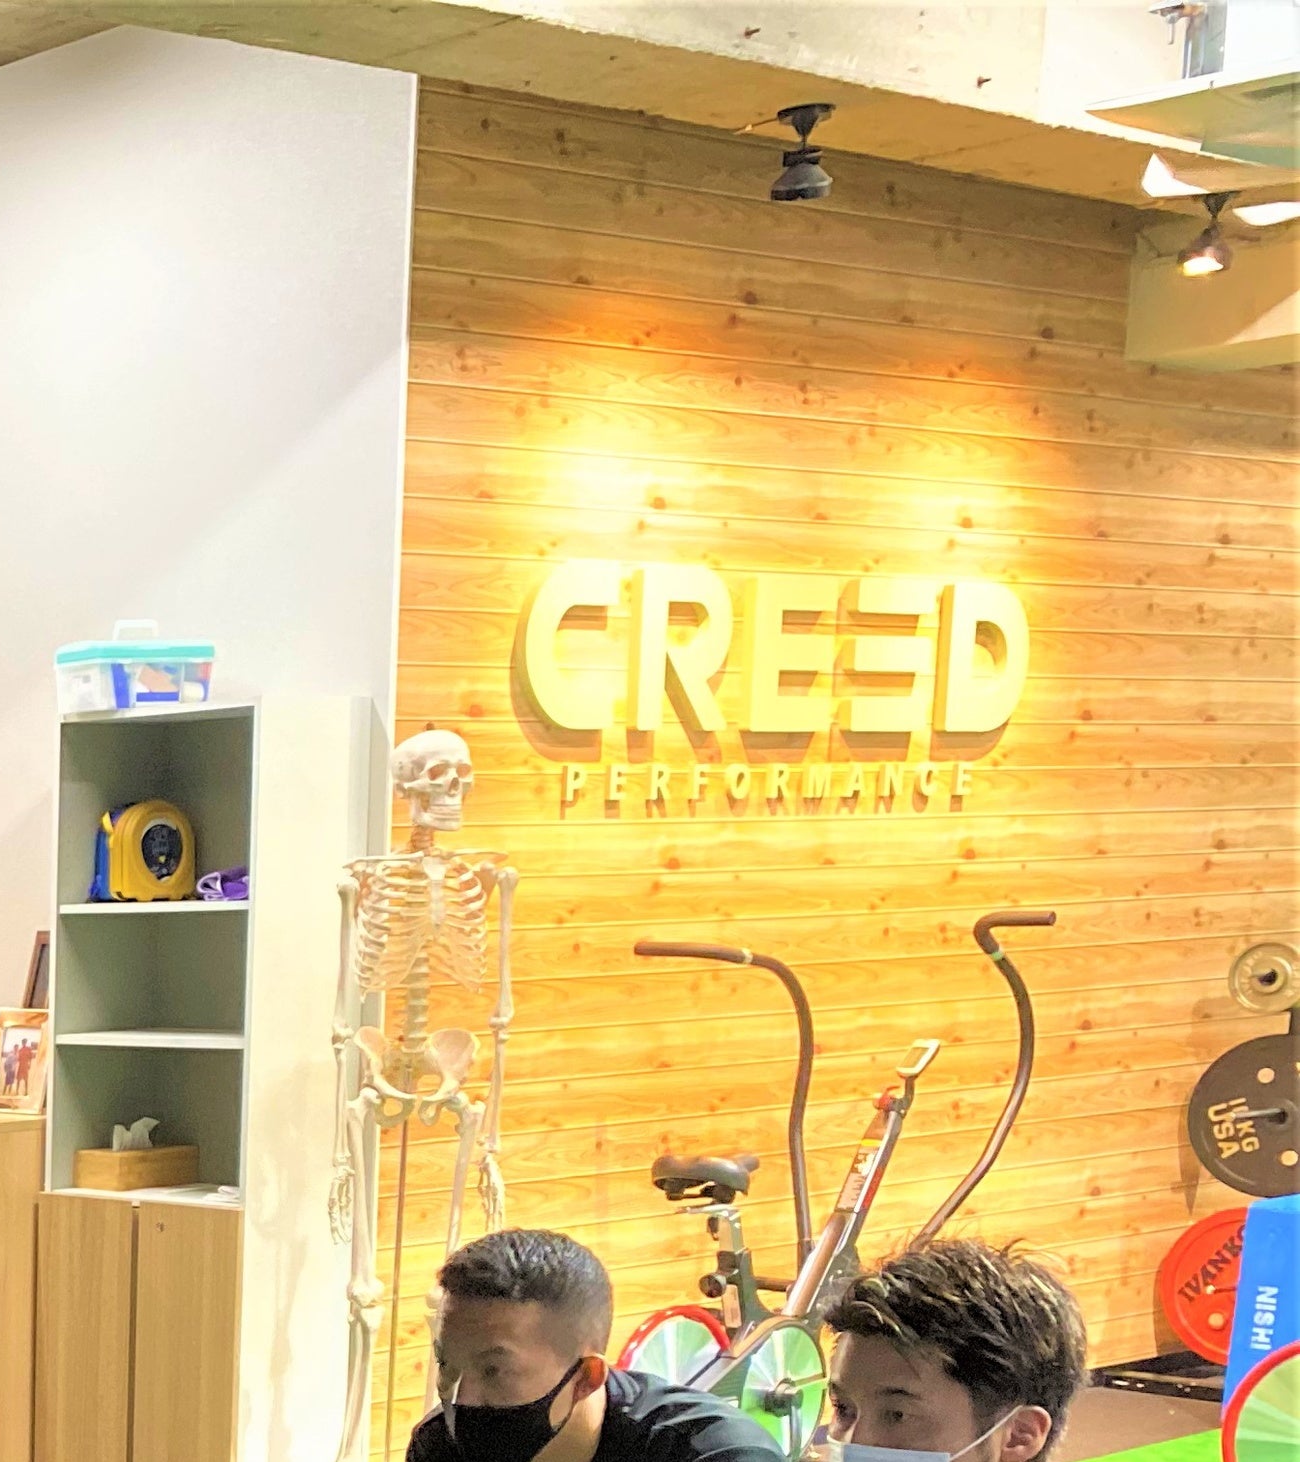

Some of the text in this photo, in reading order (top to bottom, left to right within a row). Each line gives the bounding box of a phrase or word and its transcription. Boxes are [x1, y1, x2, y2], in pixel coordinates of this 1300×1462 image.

[518, 559, 1030, 733] CREED
[562, 763, 973, 802] PERFORMANCE
[1207, 1103, 1241, 1159] USA
[1250, 1285, 1279, 1351] NISHI
